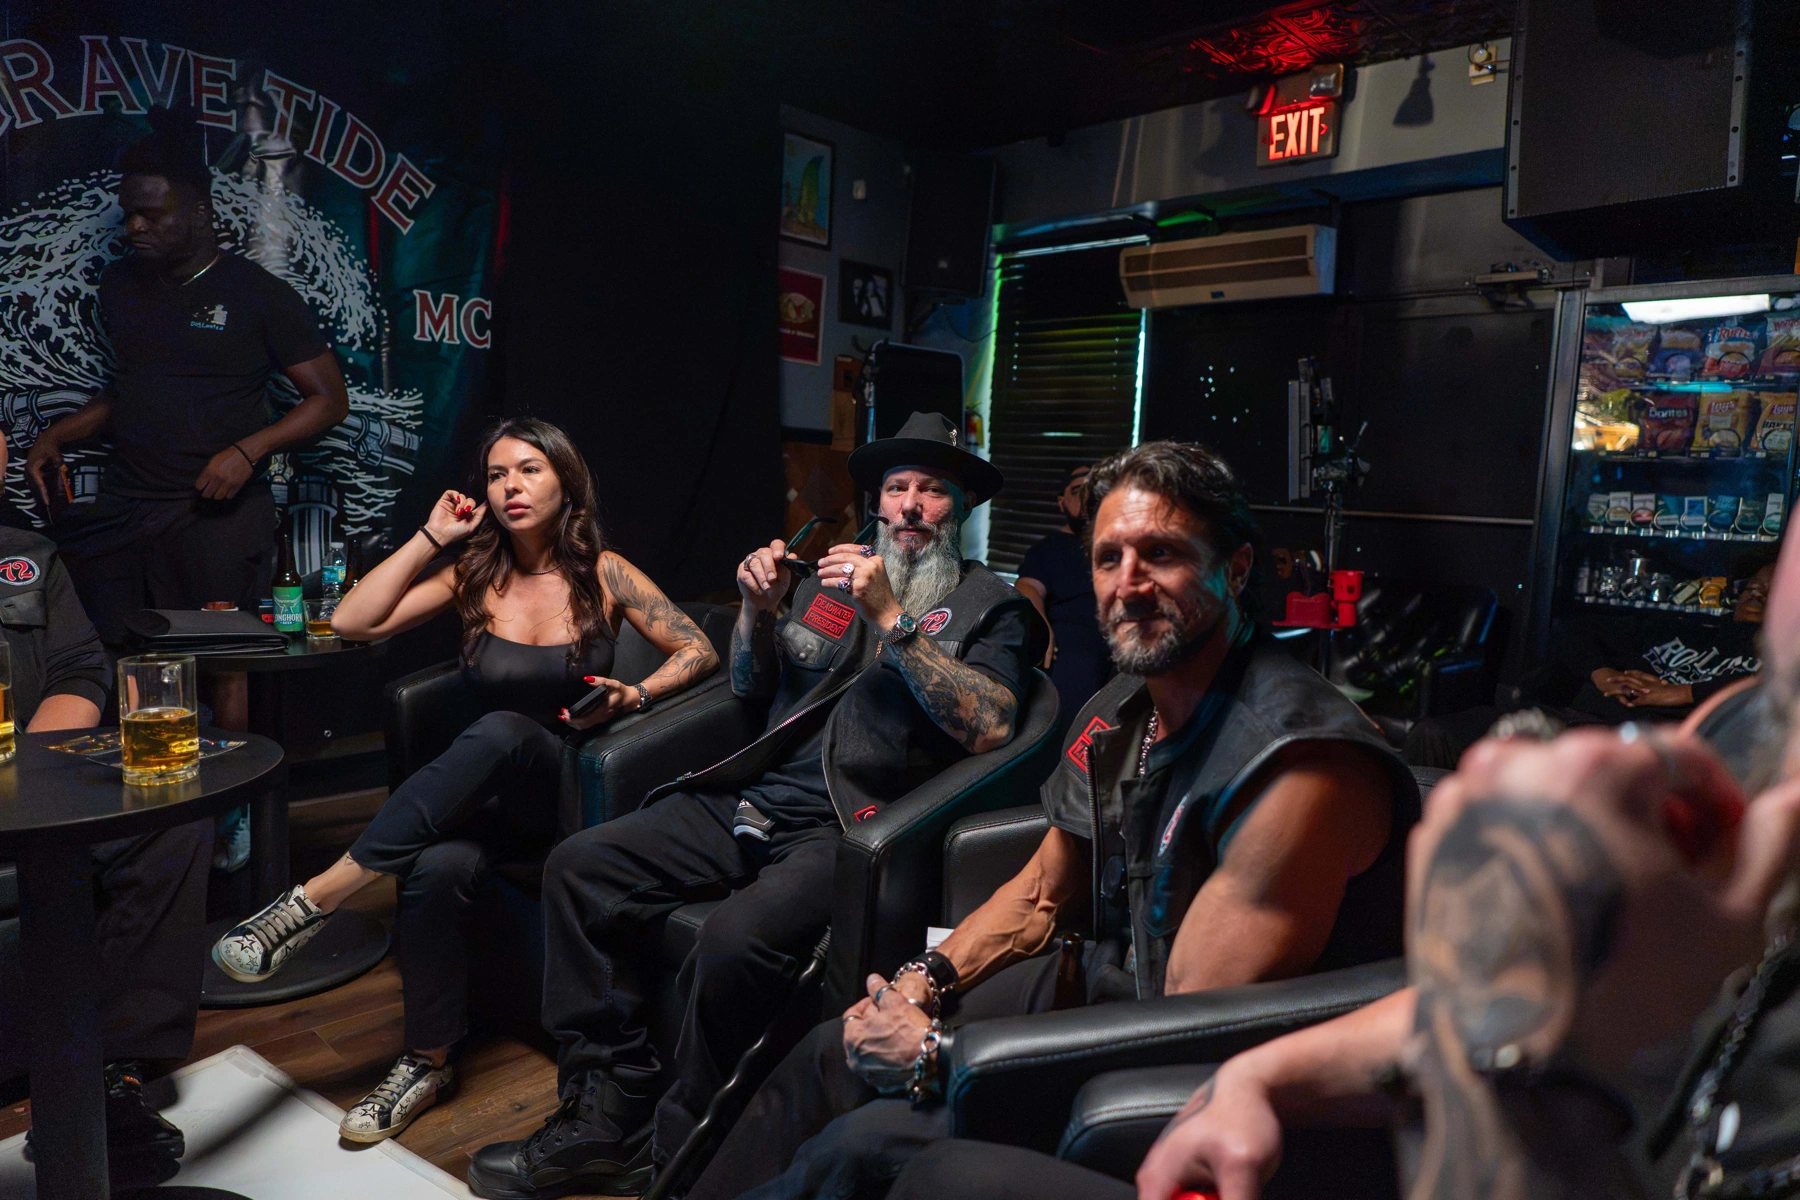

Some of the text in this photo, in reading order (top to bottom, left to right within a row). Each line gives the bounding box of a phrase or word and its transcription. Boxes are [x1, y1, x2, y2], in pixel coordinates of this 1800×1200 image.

[0, 35, 436, 236] RAVE TIDE
[1268, 106, 1326, 160] EXIT
[413, 289, 492, 349] MC
[0, 560, 34, 582] 72
[807, 611, 844, 635] PRESIDENT
[921, 612, 948, 632] 72
